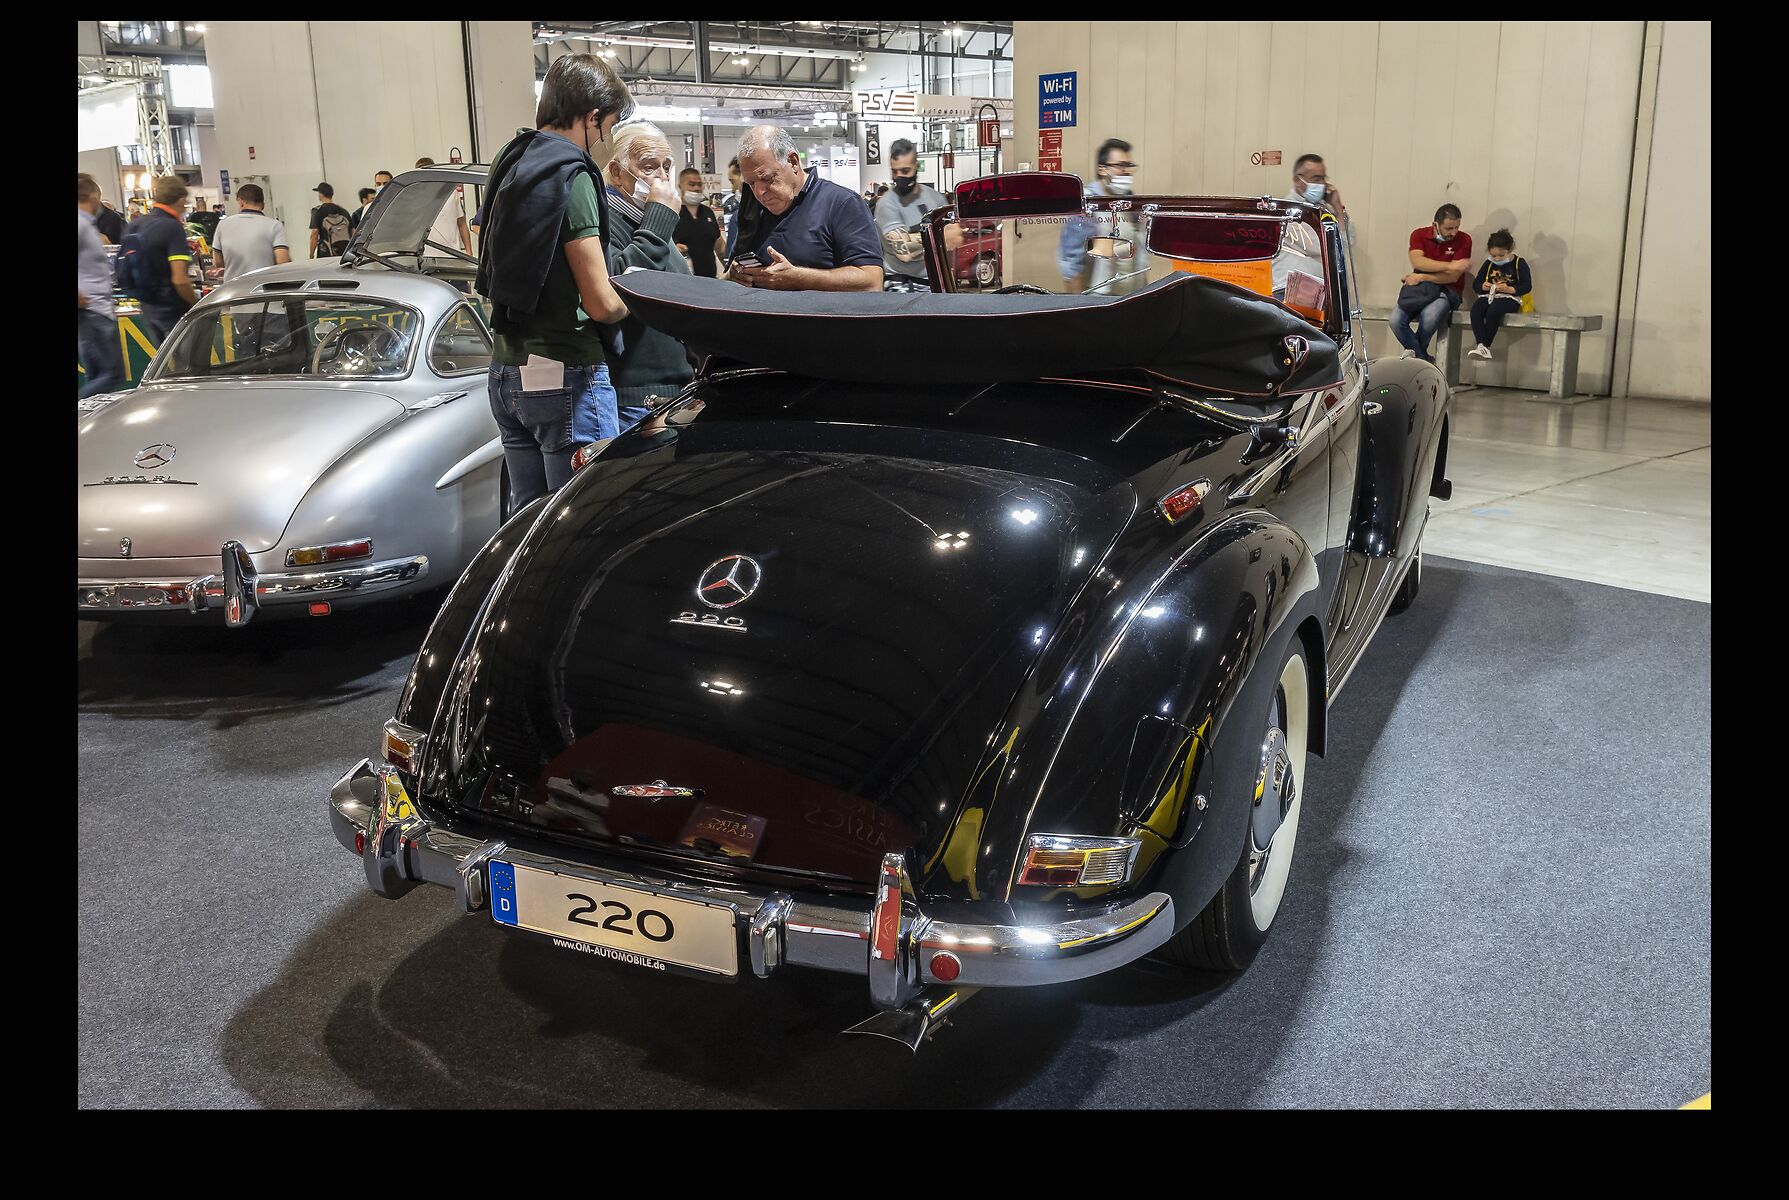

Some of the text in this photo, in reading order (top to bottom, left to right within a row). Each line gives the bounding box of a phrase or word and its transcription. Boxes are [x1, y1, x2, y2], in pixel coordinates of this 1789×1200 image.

[1043, 77, 1072, 93] Wi-Fi
[1043, 95, 1072, 106] powered by
[1054, 109, 1072, 122] TIM
[684, 148, 693, 163] T
[868, 140, 879, 158] S
[680, 611, 744, 627] 220
[501, 897, 510, 912] D
[566, 893, 675, 943] 220
[553, 938, 666, 971] www.OM-AUTOMOBILE.de
